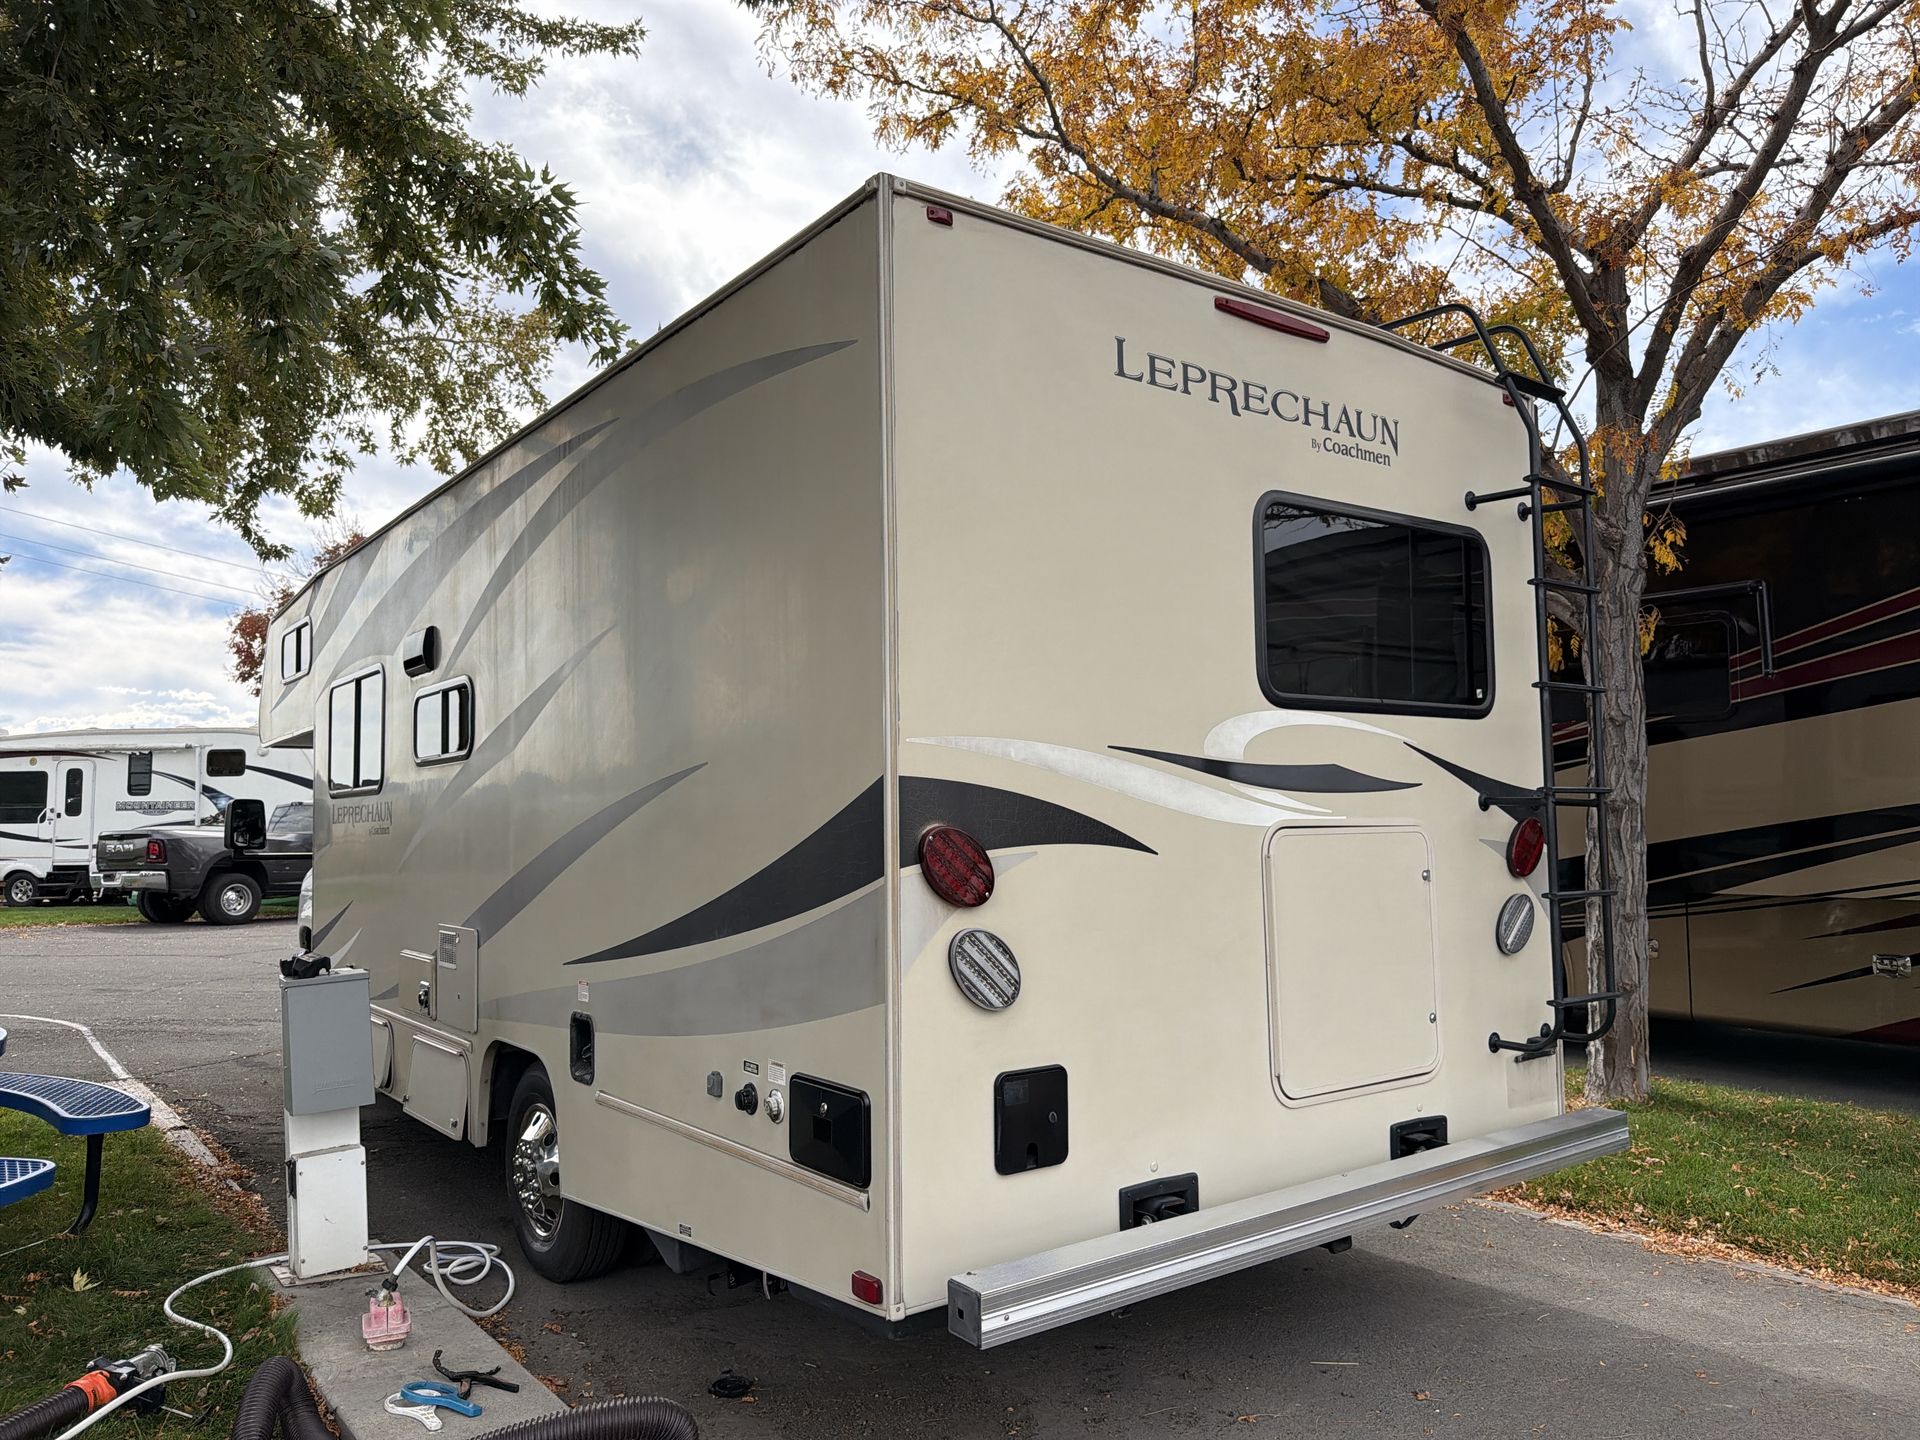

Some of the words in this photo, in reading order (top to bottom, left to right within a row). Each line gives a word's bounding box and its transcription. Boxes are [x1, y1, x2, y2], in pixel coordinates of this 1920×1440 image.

[1114, 335, 1400, 456] LEPRECHAUN
[1311, 438, 1322, 453] By
[1323, 437, 1391, 466] Coachmen
[116, 801, 195, 811] MOUNTAINEER
[332, 801, 393, 827] LEPRECHAUN
[106, 844, 134, 853] RAM
